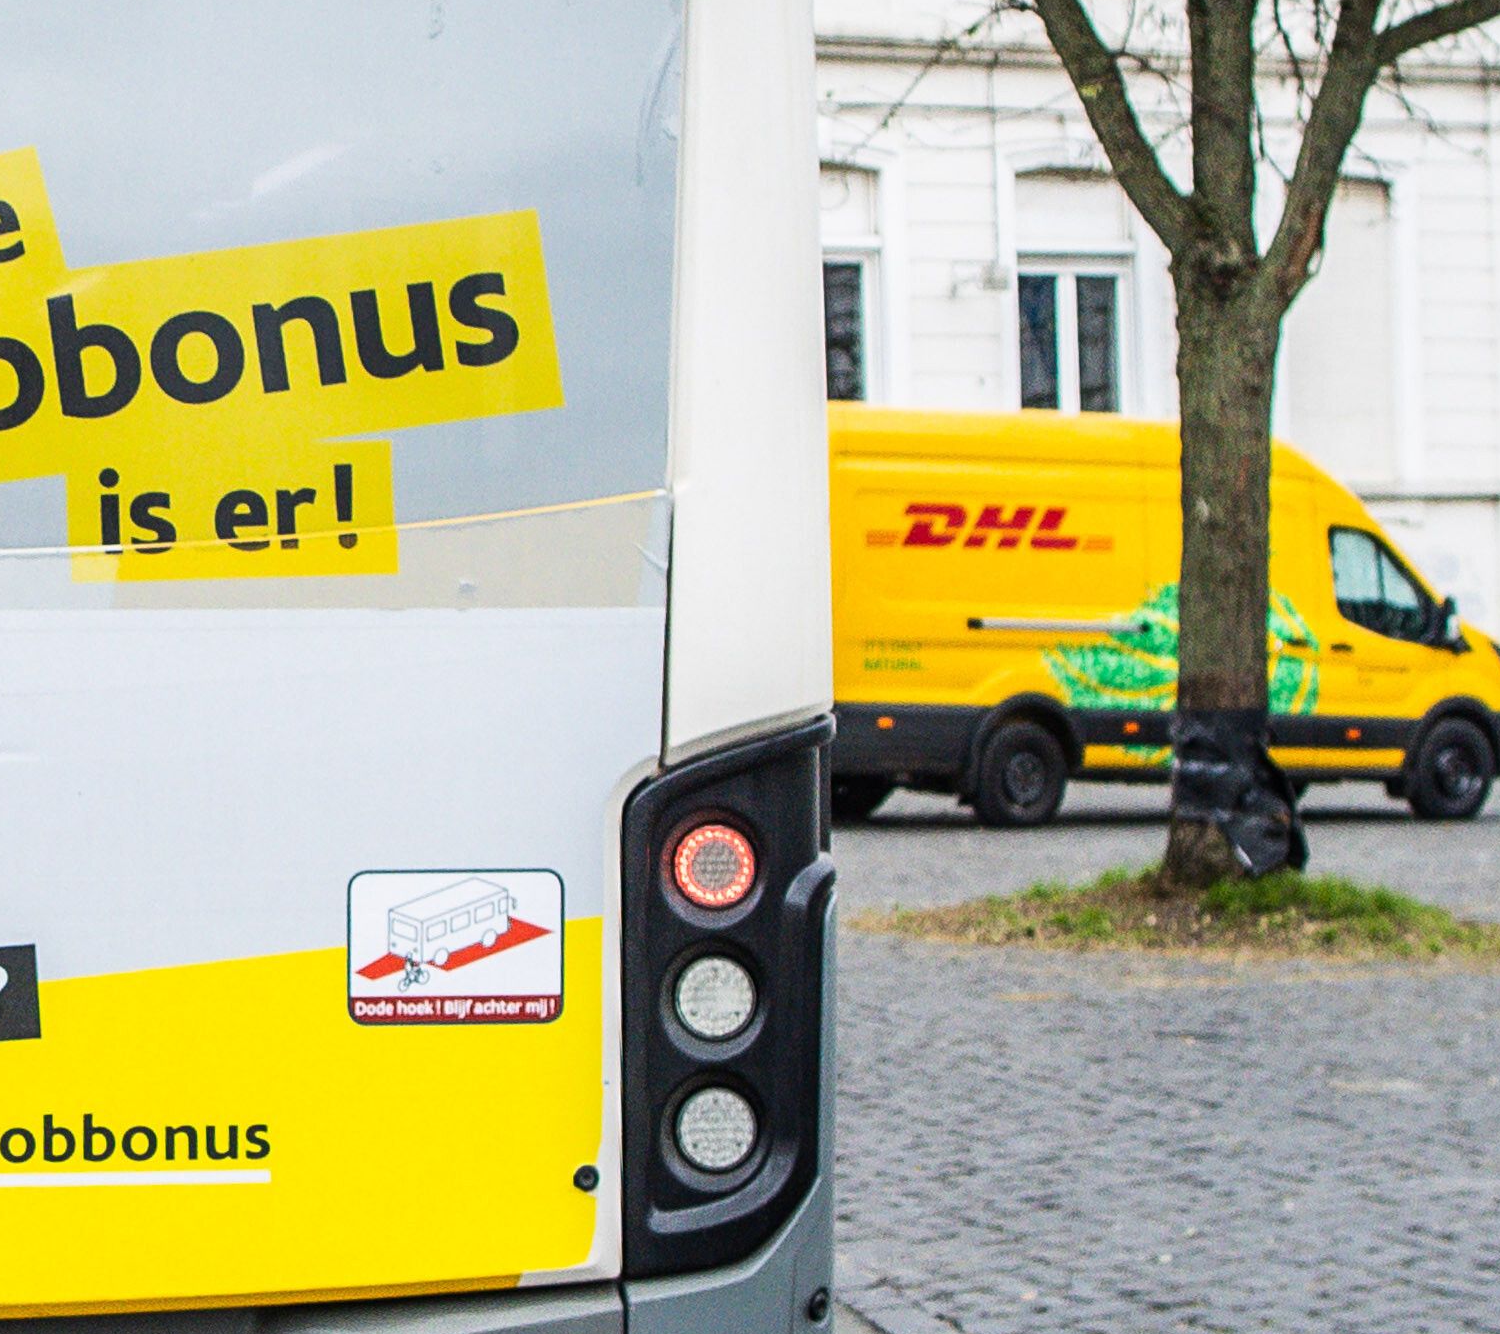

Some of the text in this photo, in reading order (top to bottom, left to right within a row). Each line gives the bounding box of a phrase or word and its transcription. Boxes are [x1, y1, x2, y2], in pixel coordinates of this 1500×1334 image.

[98, 462, 359, 555] is er!
[902, 503, 1079, 551] DHL
[354, 1000, 394, 1016] Dode
[444, 999, 473, 1018] Blijf
[474, 999, 521, 1015] achter
